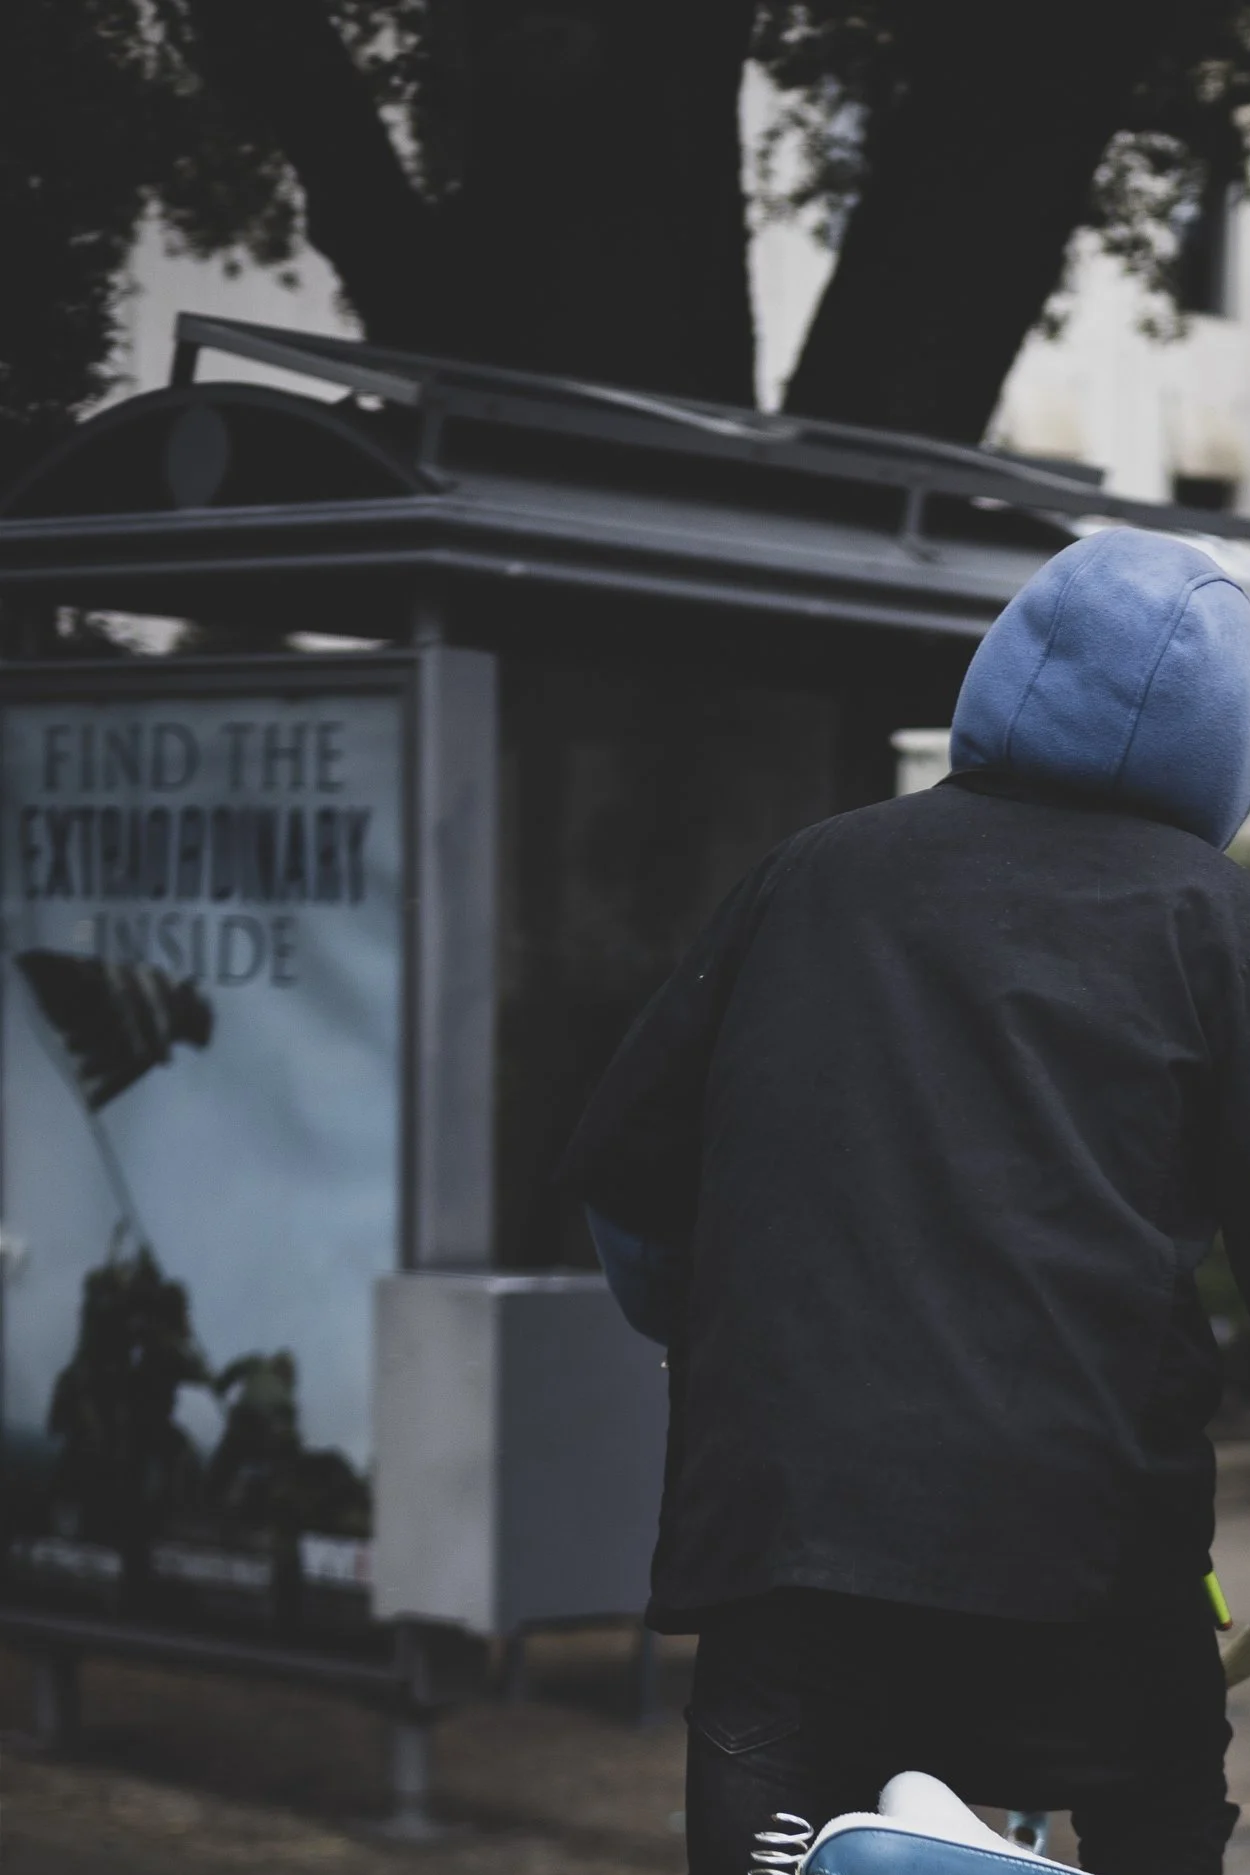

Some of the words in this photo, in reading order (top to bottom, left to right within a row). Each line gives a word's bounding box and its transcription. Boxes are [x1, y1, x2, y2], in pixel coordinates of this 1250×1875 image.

[41, 721, 198, 793] FIND
[222, 720, 344, 793] THE
[95, 911, 299, 987] INSIDE
